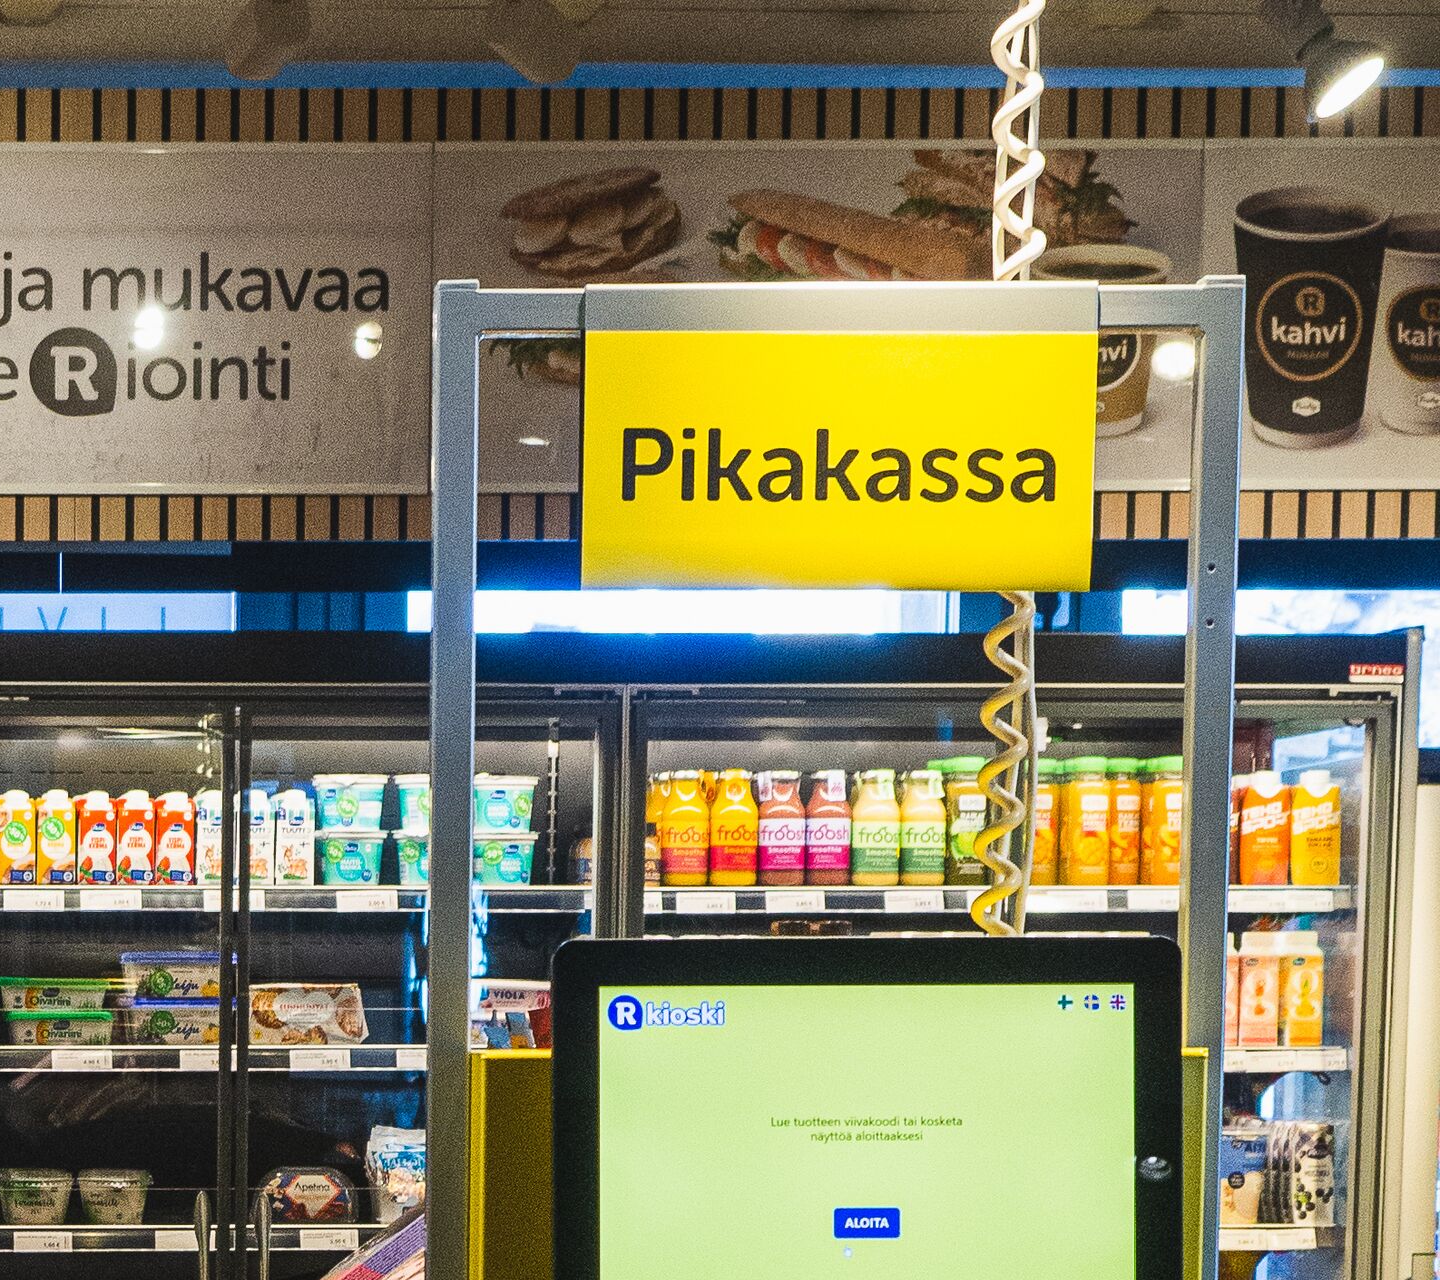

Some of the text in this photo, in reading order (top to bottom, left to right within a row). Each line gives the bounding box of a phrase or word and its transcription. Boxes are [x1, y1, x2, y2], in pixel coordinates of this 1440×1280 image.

[82, 251, 390, 313] mukavaa
[1271, 316, 1347, 346] kahvi
[621, 425, 1058, 505] Pikakassa
[493, 990, 526, 1000] VIOLA
[646, 1001, 725, 1026] kioski
[770, 1116, 963, 1128] Lue tuotteen viivakoodi tai kosketa
[810, 1131, 923, 1144] näyttöä aloittaaksesi
[844, 1217, 890, 1229] ALOITA
